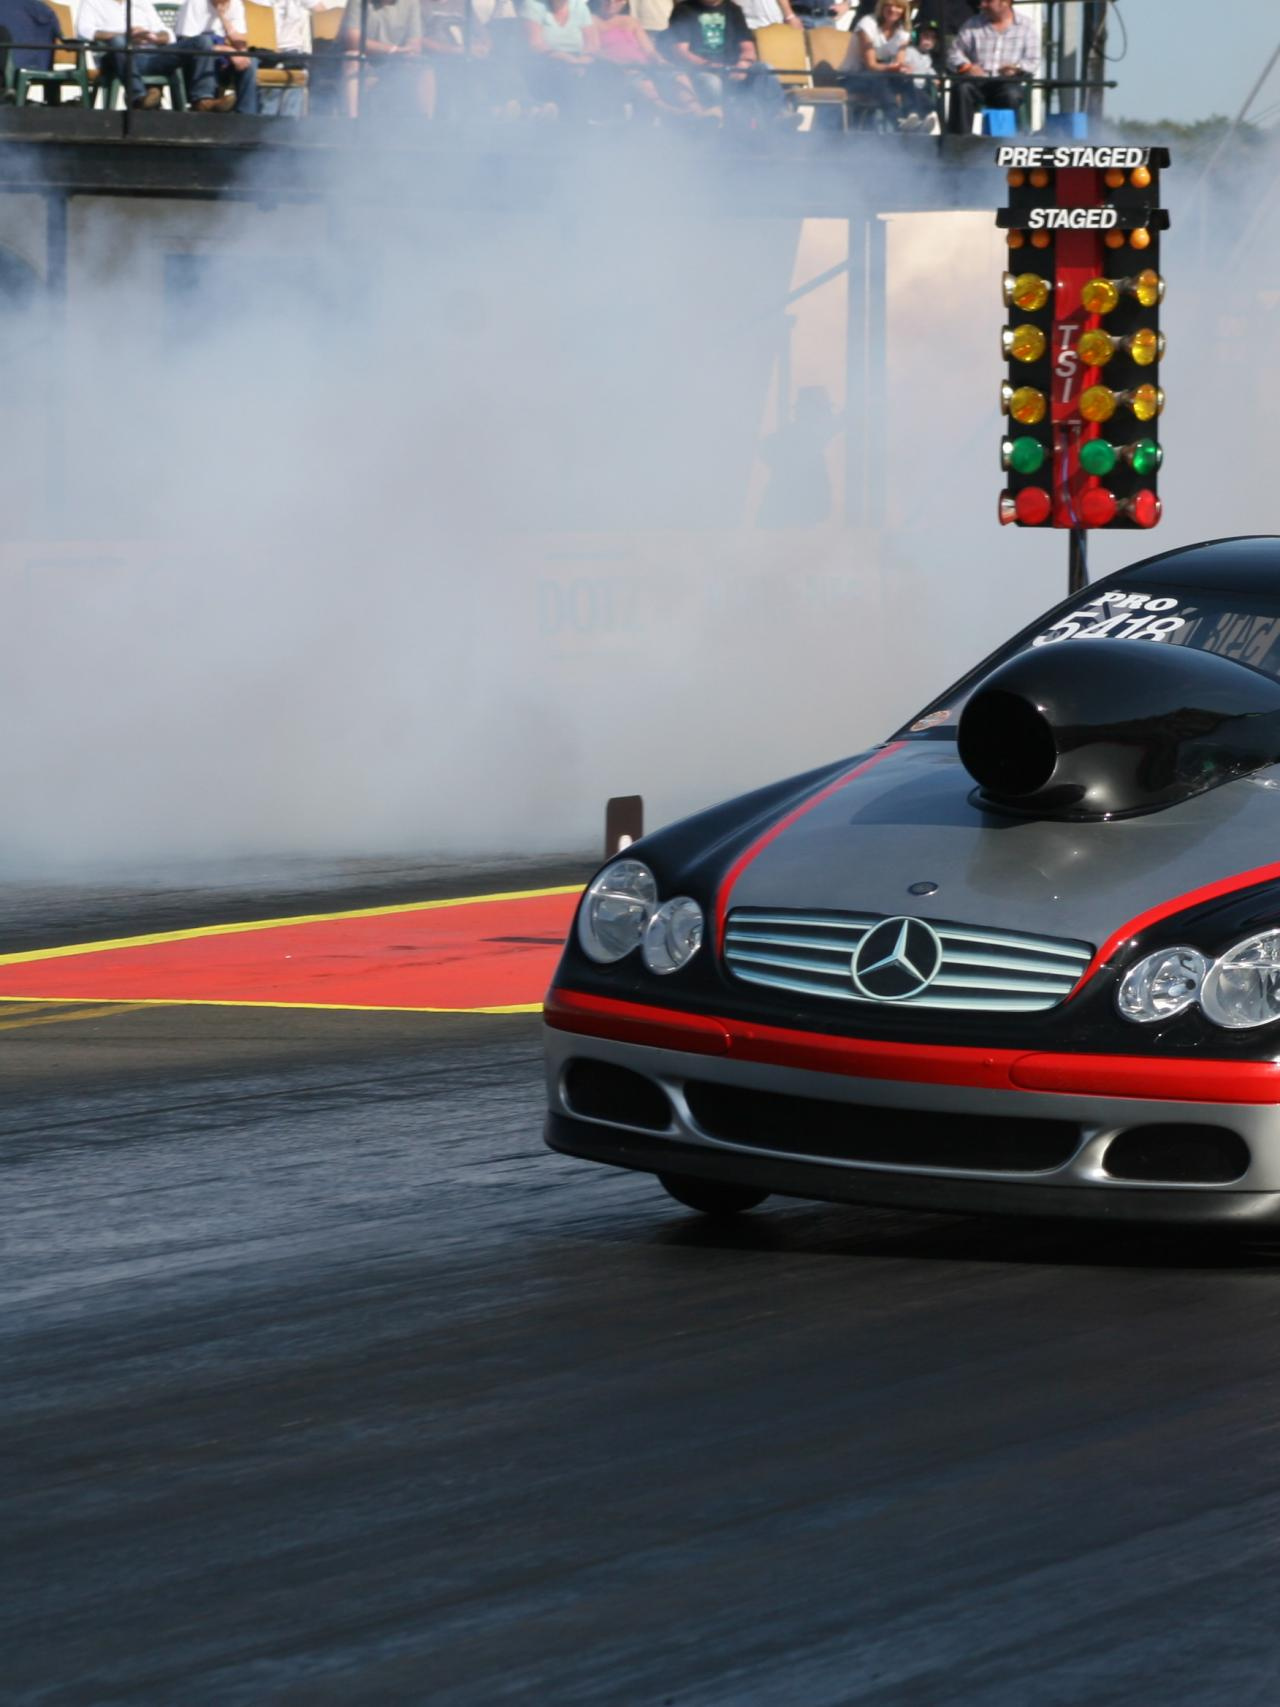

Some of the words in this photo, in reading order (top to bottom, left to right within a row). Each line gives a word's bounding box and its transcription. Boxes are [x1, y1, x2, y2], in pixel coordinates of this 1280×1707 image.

[997, 147, 1144, 168] PRE-STAGED
[1027, 208, 1118, 228] STAGED
[1090, 591, 1178, 611] PRO
[1032, 611, 1186, 647] 5418
